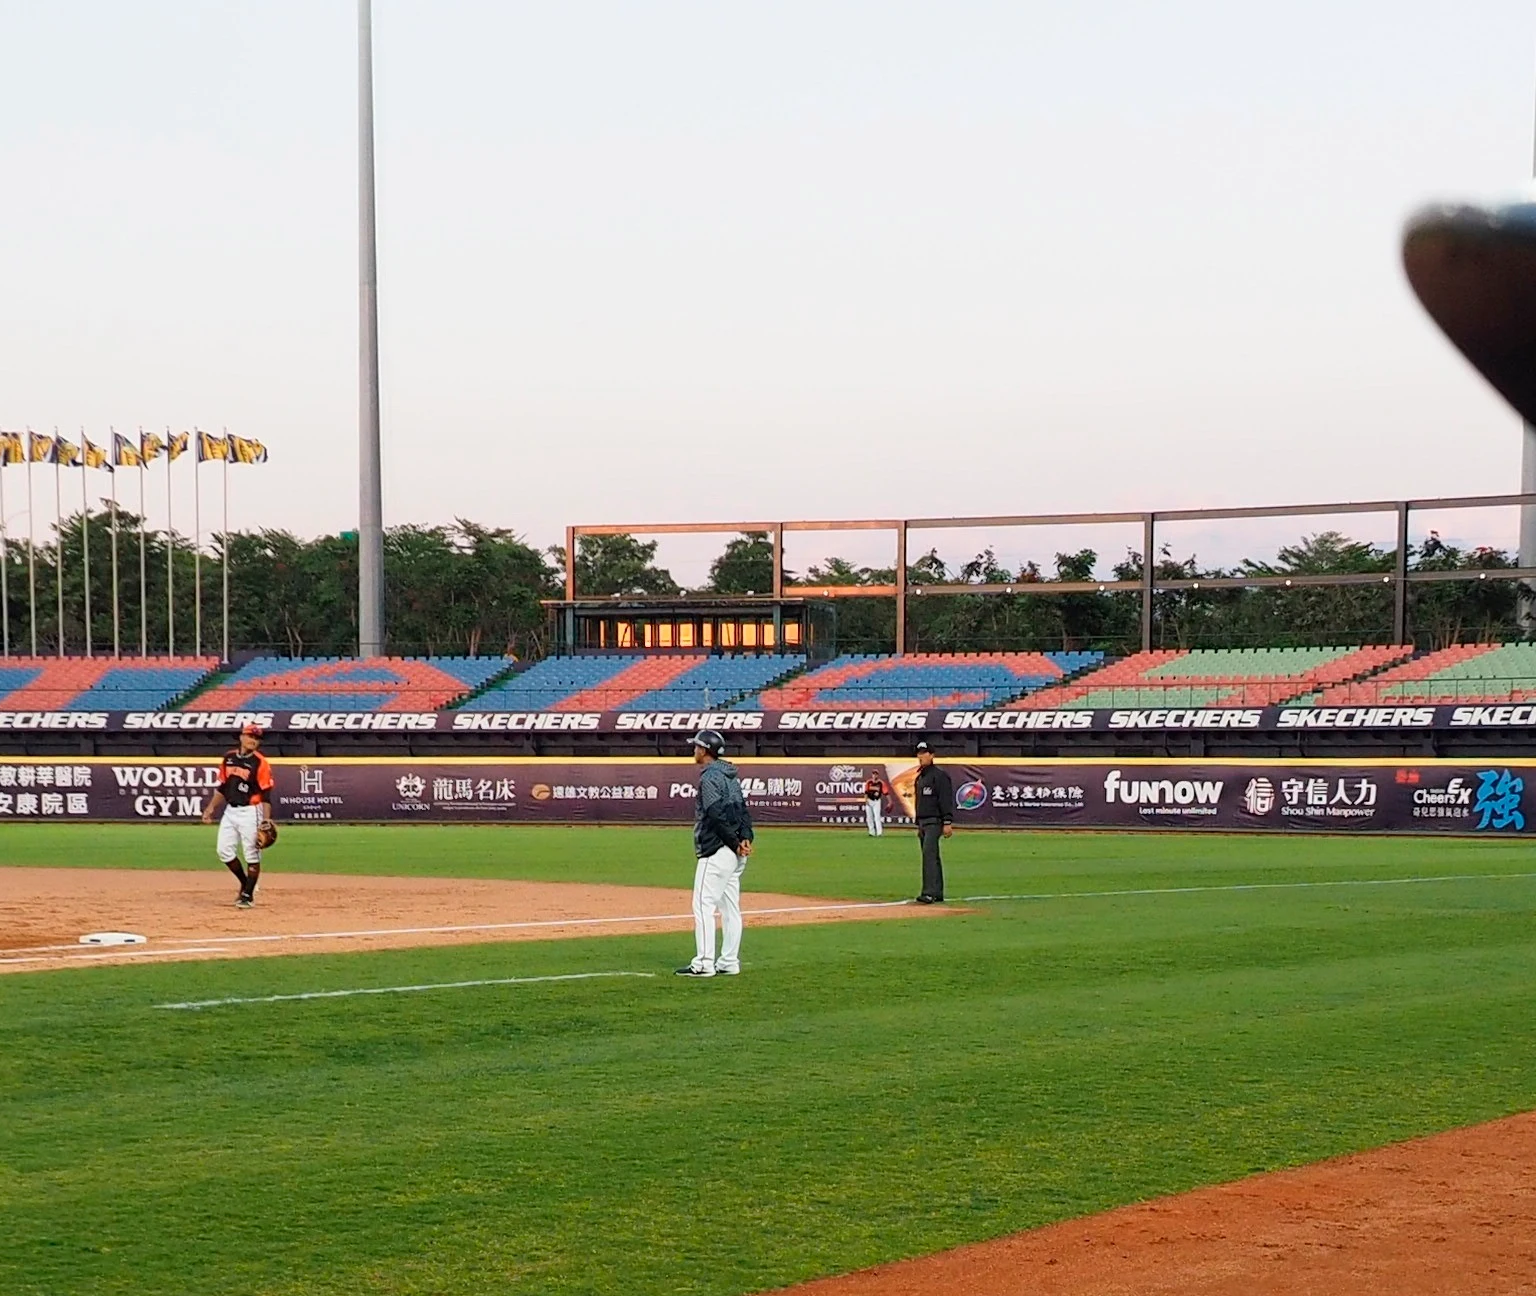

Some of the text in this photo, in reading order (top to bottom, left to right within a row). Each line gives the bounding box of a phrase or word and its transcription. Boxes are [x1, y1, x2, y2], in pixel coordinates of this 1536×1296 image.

[123, 712, 273, 729] SKECHERS
[289, 712, 437, 729] SKECHERS
[453, 713, 601, 729] SKECHERS
[615, 712, 763, 729] SKECHERS
[778, 711, 928, 729] SKECHERS
[943, 710, 1093, 728] SKECHERS
[1109, 709, 1262, 728] SKECHERS
[1277, 707, 1435, 728] SKECHERS
[112, 766, 222, 788] WORLD
[433, 777, 516, 801] 龍馬名床
[1281, 778, 1377, 806] 守信人力
[1413, 788, 1456, 805] Cheers
[135, 795, 203, 817] GYM
[392, 803, 431, 811] UNICORN
[1473, 768, 1525, 831] 強
[1281, 806, 1376, 818] Shou Shin Manpower
